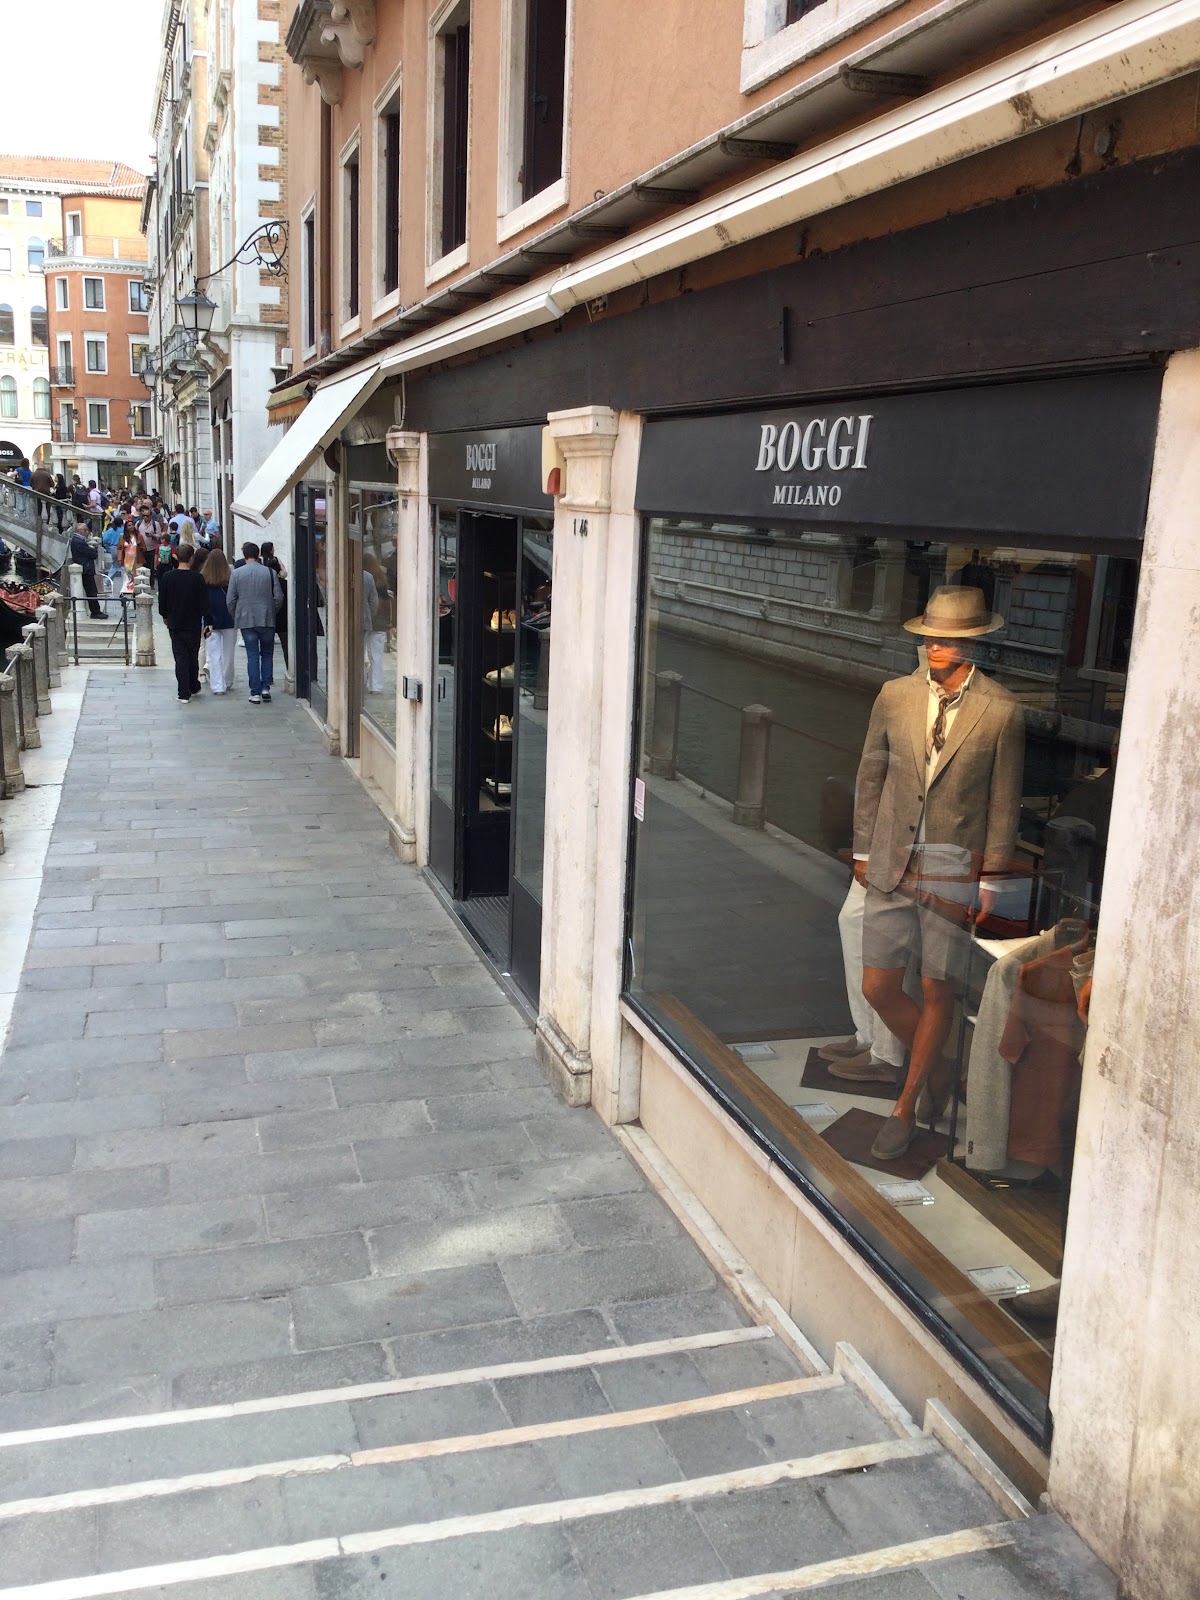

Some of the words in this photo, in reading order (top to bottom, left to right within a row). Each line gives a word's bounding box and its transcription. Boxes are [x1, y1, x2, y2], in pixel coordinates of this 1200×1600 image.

[755, 415, 874, 472] BOGGI
[465, 443, 497, 471] BOGGI
[472, 477, 492, 490] MILANO
[772, 485, 842, 506] MILANO
